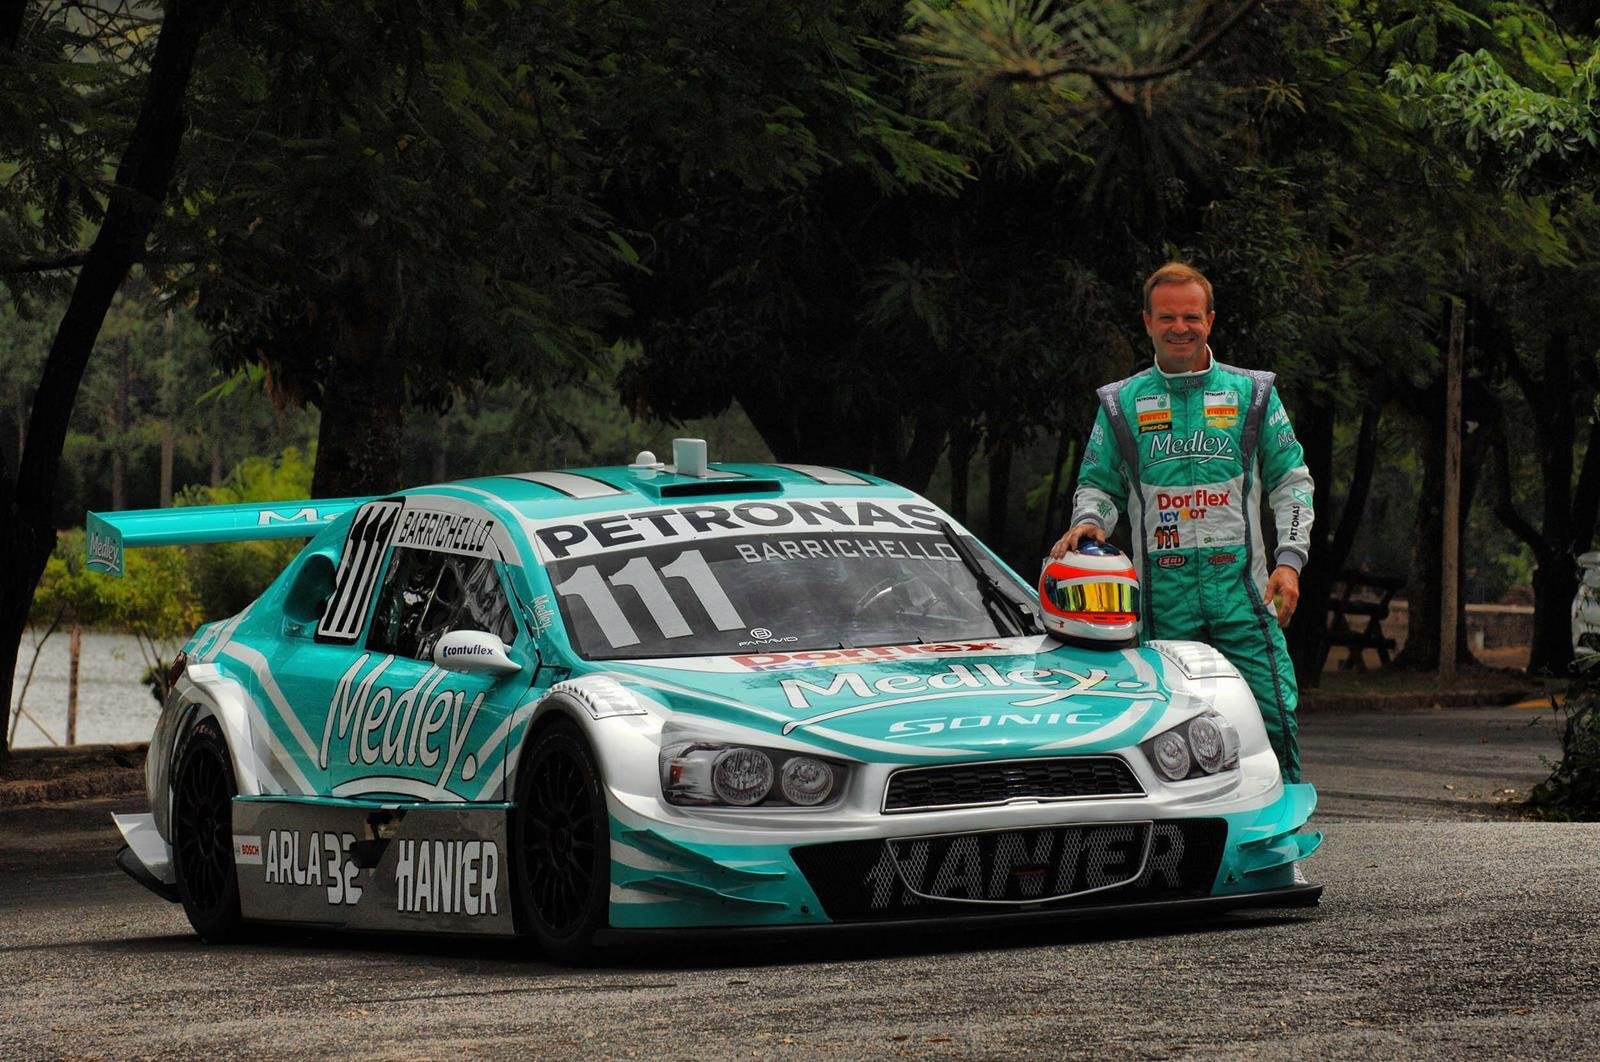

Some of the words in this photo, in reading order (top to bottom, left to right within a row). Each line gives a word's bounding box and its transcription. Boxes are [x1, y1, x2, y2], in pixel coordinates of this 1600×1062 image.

[398, 511, 494, 551] BARRICHELLO
[535, 502, 942, 559] PETRONAS
[1160, 511, 1180, 523] ICY
[735, 539, 962, 564] BARRICHELLO
[1154, 525, 1180, 549] 111
[322, 506, 400, 633] 111
[556, 550, 746, 649] 111
[445, 646, 494, 657] contuflex
[729, 643, 1008, 669] Dorflex
[738, 636, 799, 647] FANAVID
[319, 652, 486, 799] Medley.
[884, 713, 1103, 739] SONIC
[241, 844, 260, 856] BOSCH
[265, 829, 321, 886] ARLA
[324, 833, 362, 904] 32
[394, 840, 498, 916] HANIER
[863, 826, 1184, 909] HANIER
